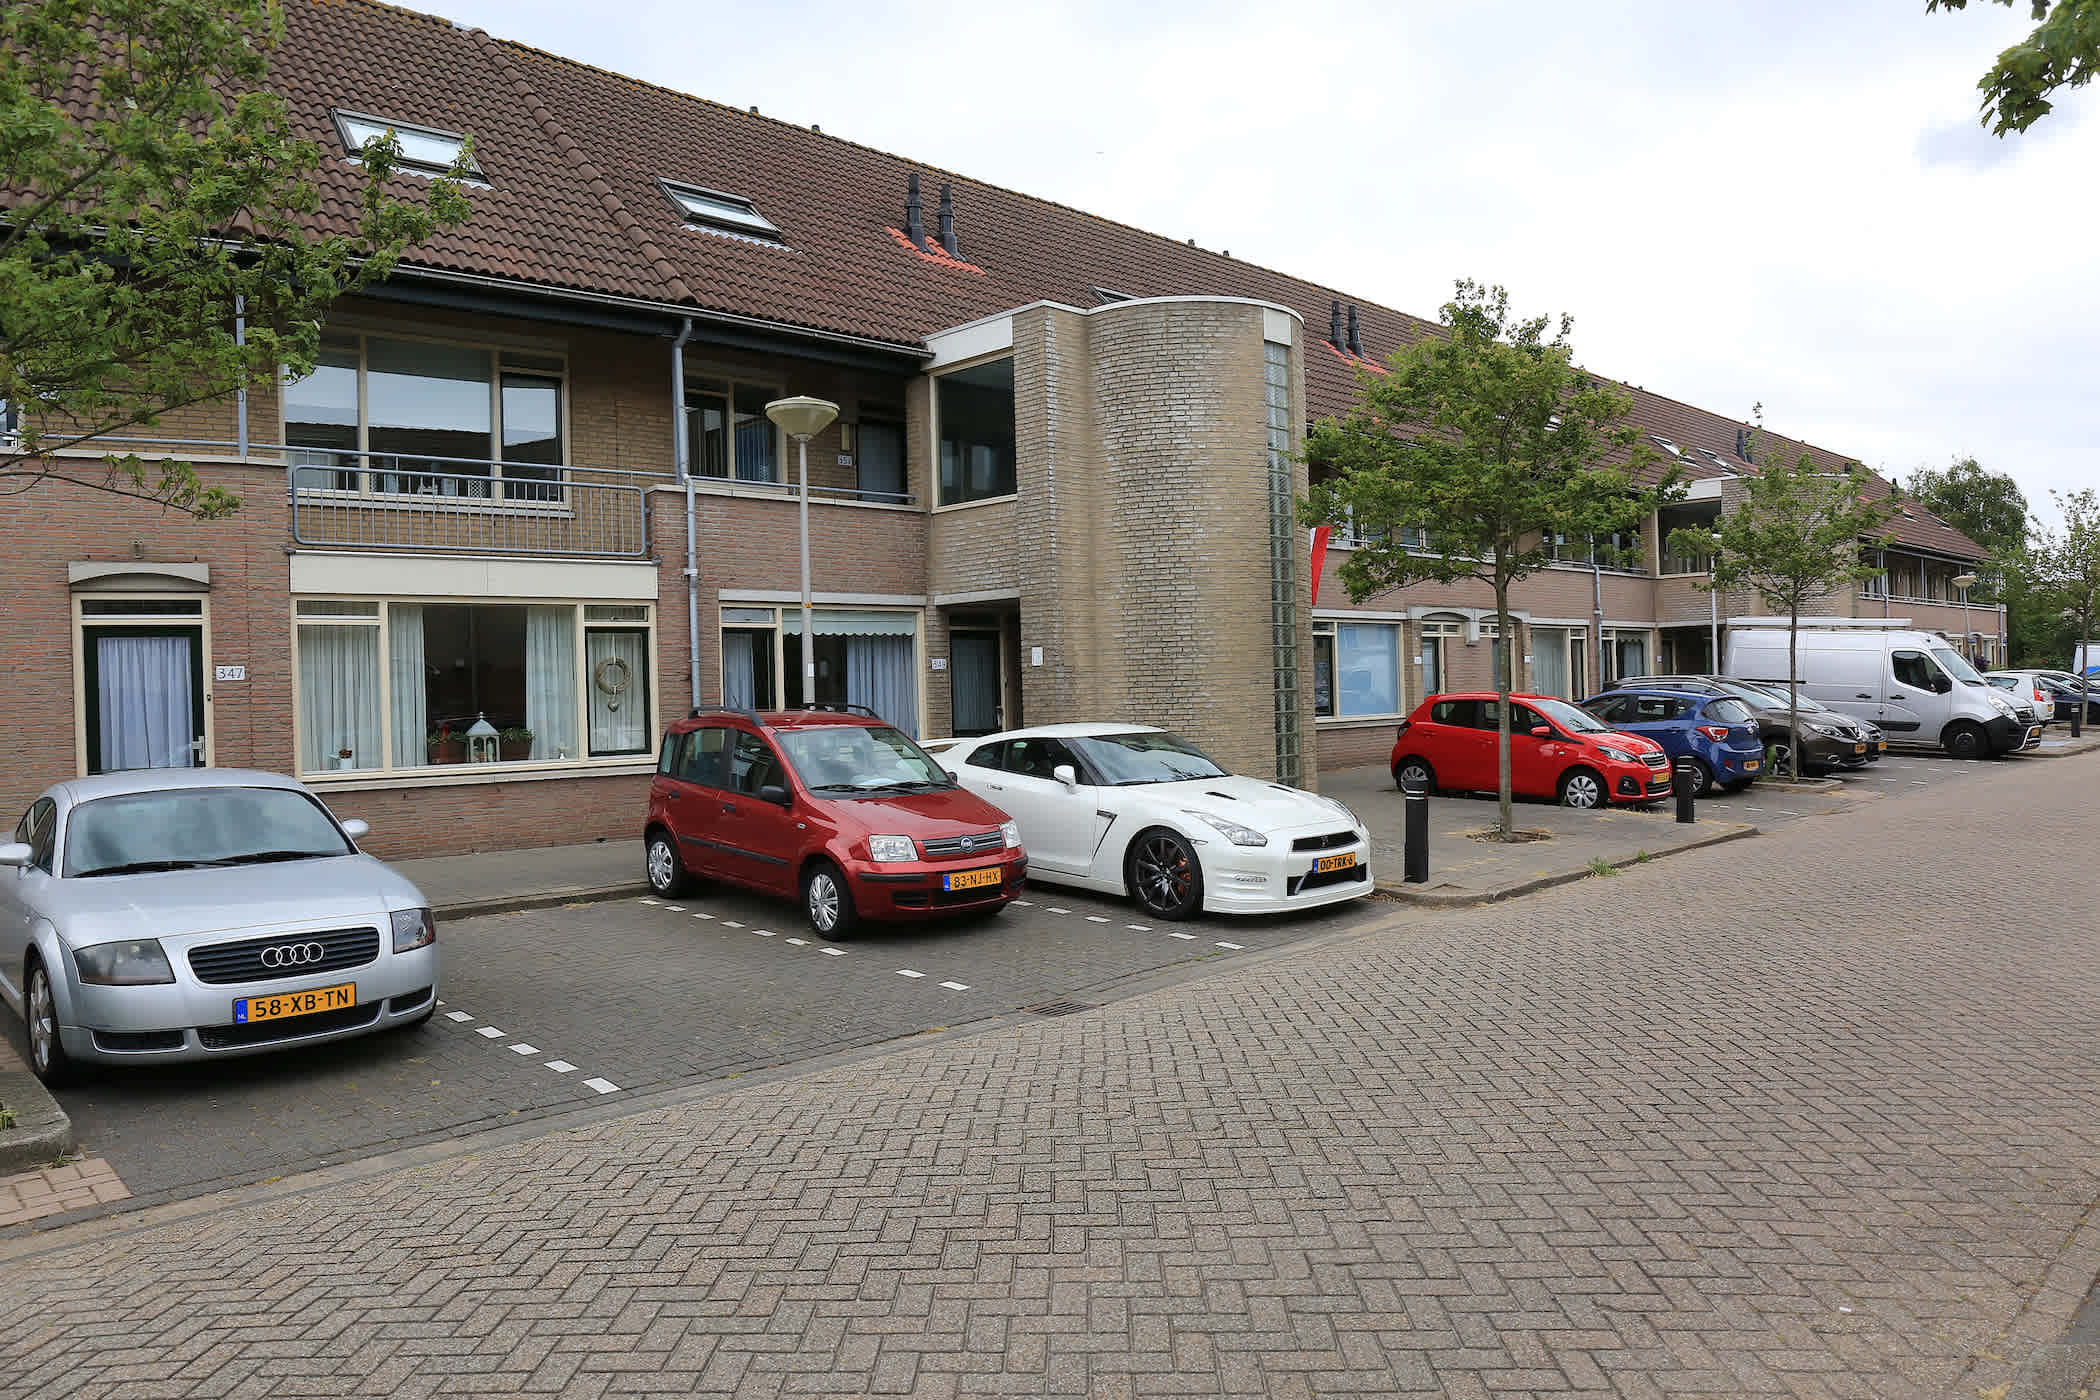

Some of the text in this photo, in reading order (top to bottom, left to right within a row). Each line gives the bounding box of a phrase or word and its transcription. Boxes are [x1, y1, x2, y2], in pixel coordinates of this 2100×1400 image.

[217, 667, 243, 679] 347
[954, 871, 998, 888] 83-NJ-HX
[255, 988, 349, 1017] 58-XB-TN
